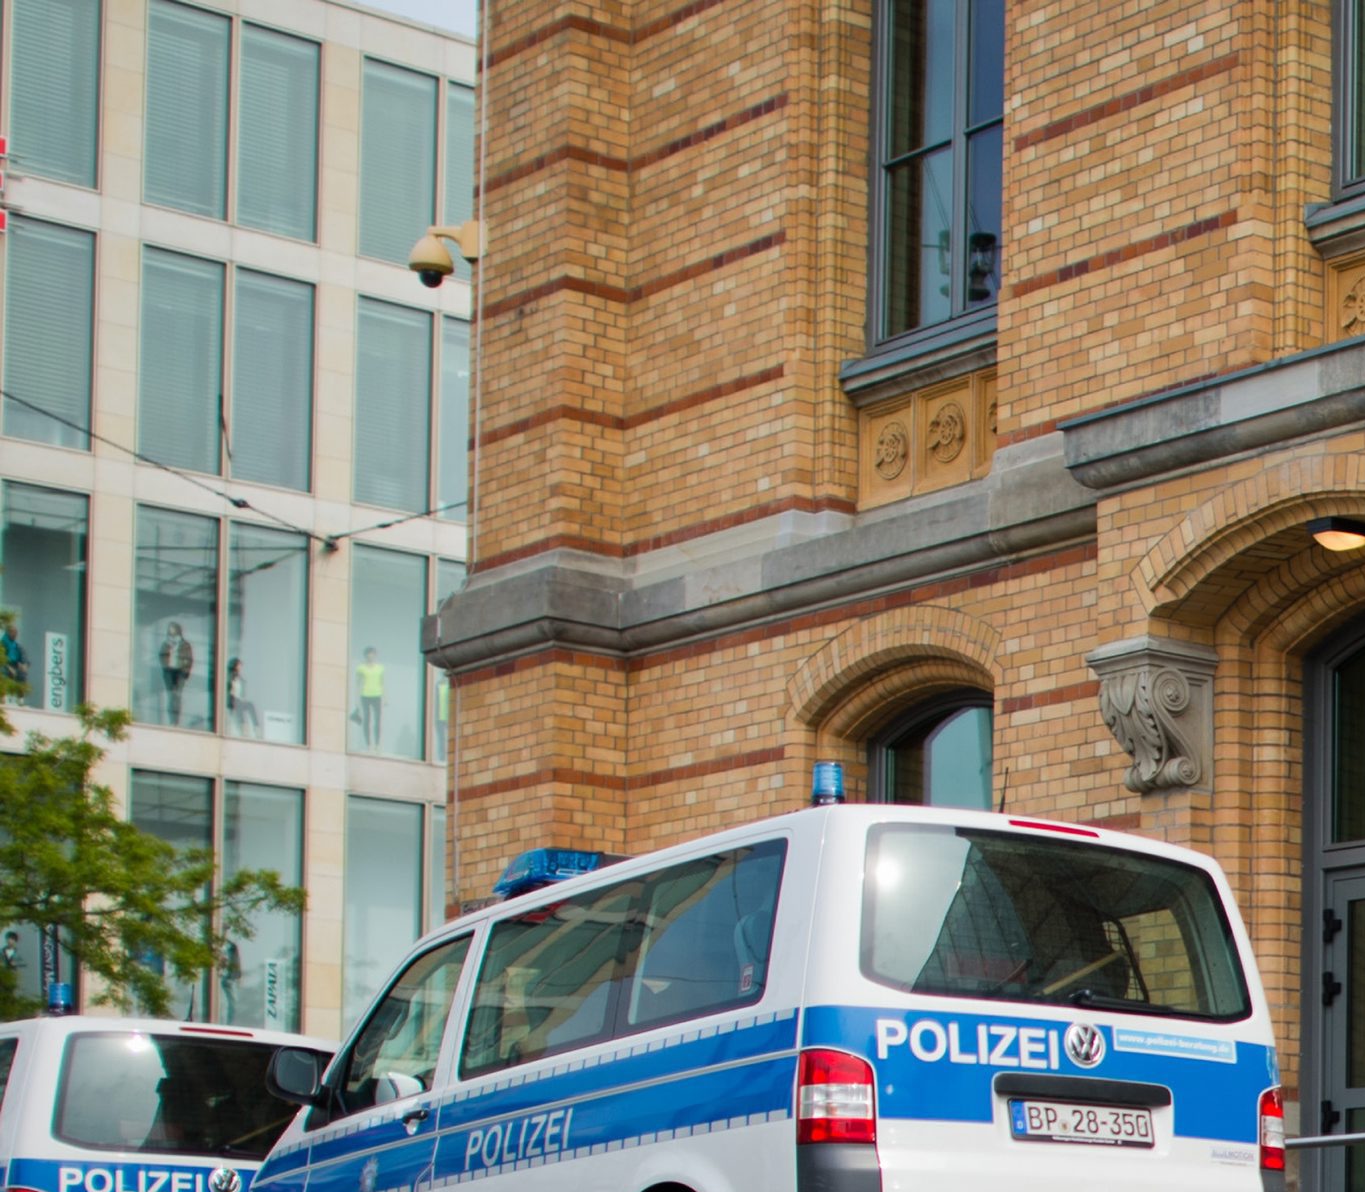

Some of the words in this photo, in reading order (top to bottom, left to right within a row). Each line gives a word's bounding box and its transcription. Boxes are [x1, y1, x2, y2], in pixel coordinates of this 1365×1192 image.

[49, 638, 66, 709] engbers
[267, 962, 277, 1020] ZAPATA
[875, 1018, 1060, 1071] POLIZEI
[464, 1107, 574, 1170] POLIZEI
[1027, 1106, 1058, 1131] BP
[1071, 1109, 1149, 1138] 28-350
